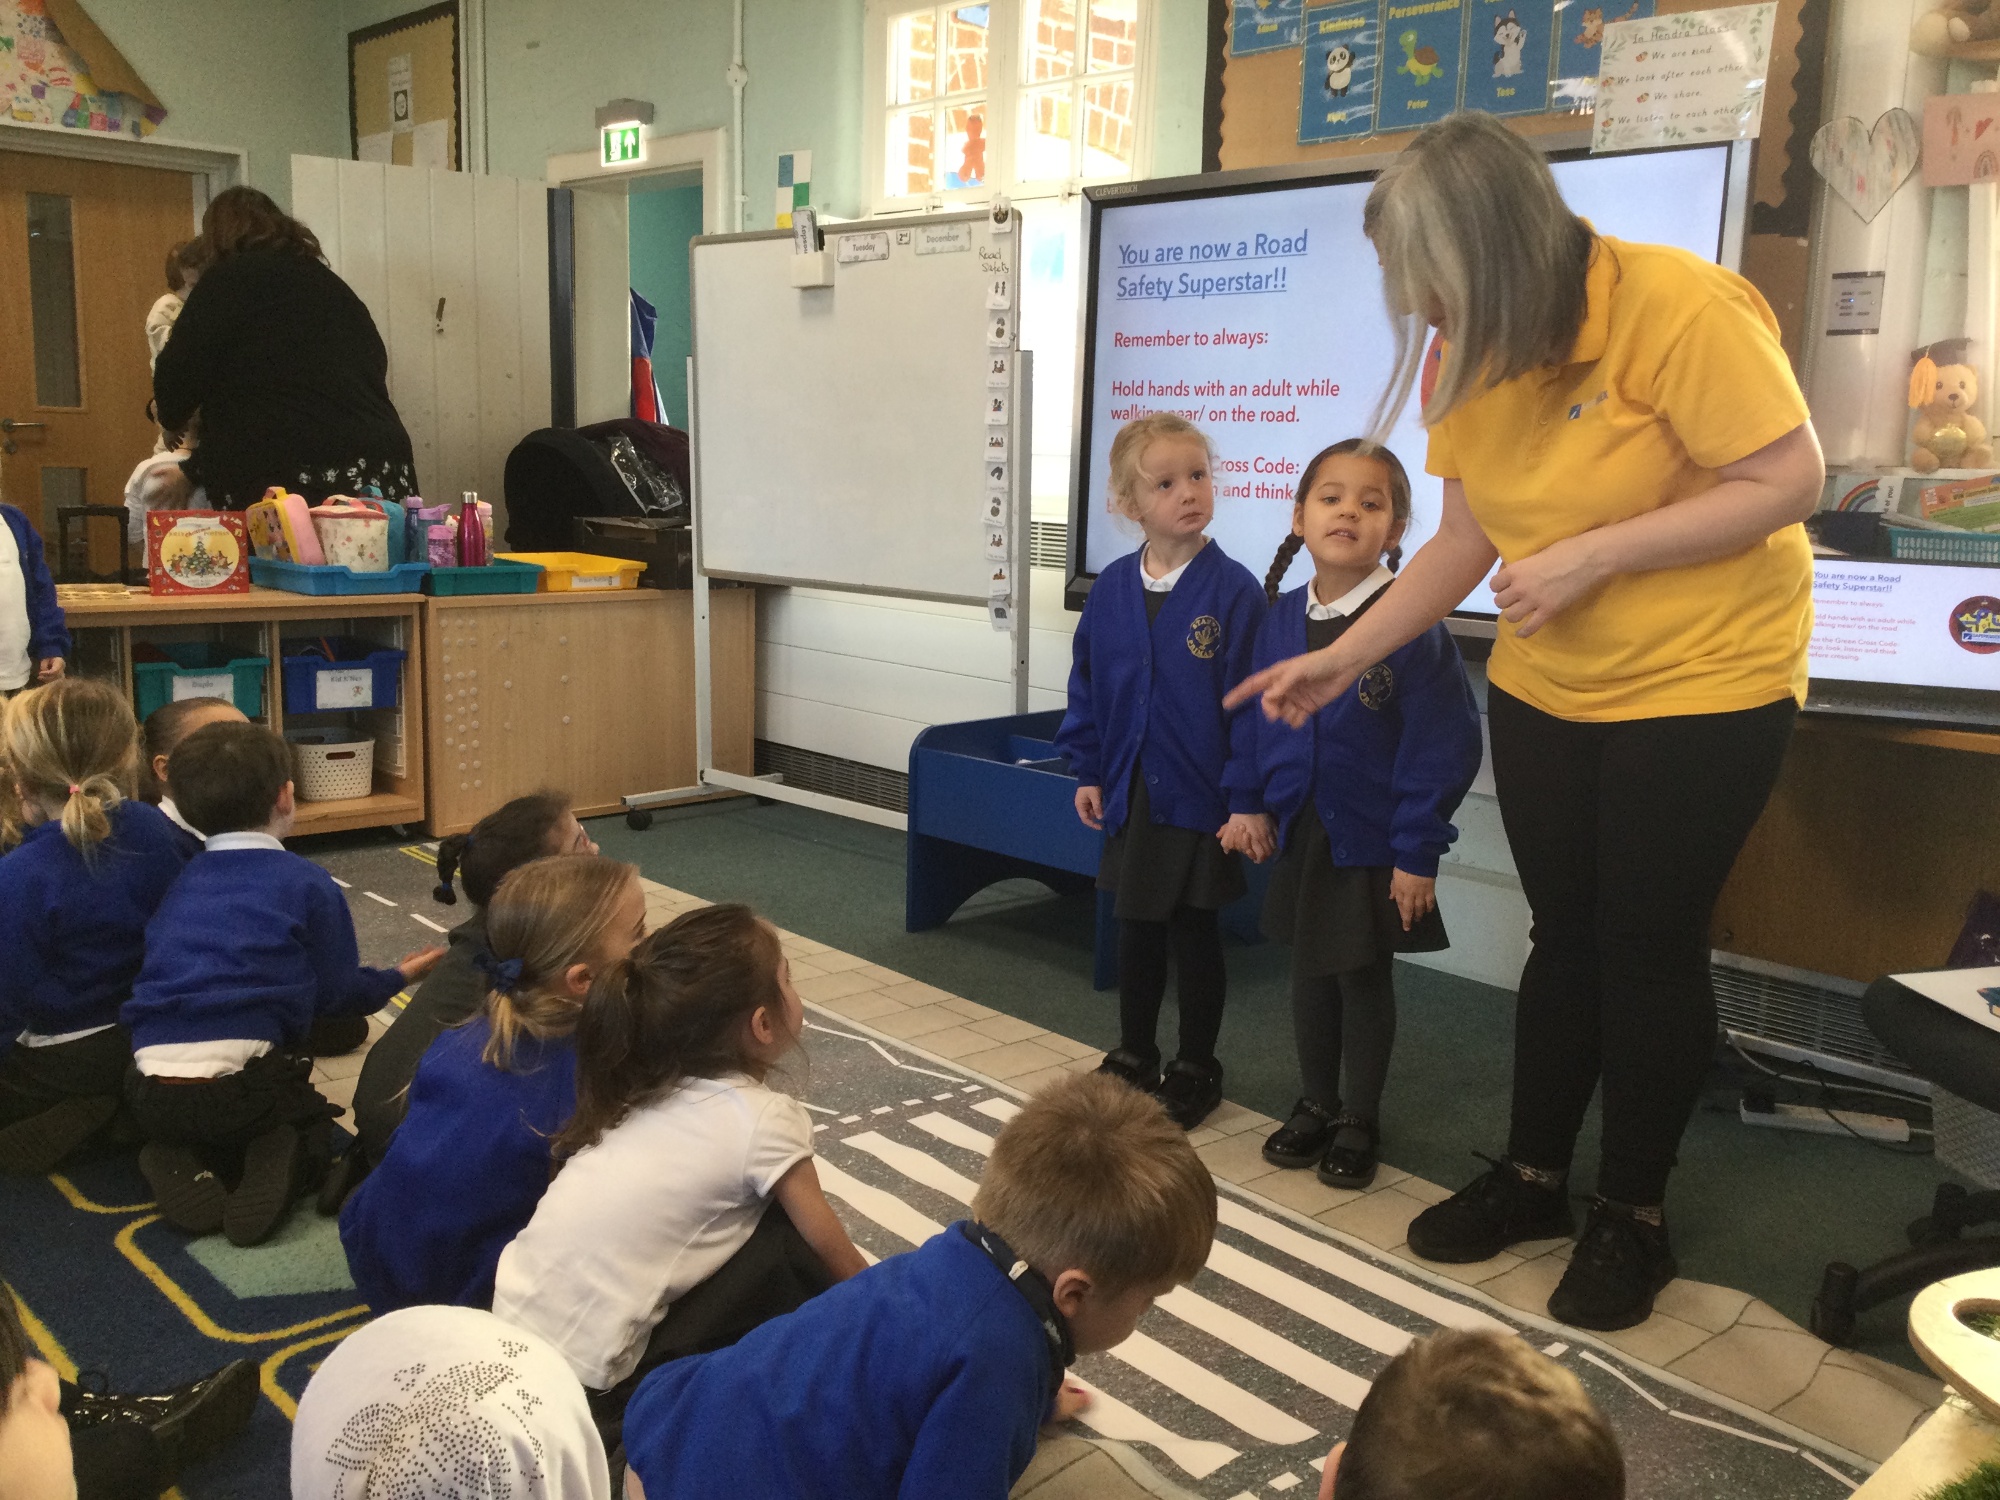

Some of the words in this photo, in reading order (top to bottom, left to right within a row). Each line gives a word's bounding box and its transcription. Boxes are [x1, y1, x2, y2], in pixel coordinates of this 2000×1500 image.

[1698, 26, 1730, 36] Class
[1652, 52, 1666, 60] We
[1617, 76, 1630, 84] We
[1635, 73, 1655, 83] look
[1660, 70, 1685, 82] after
[1690, 67, 1712, 76] each
[800, 224, 808, 254] nesday
[852, 243, 876, 253] Tuesday
[926, 234, 960, 244] December
[1119, 244, 1150, 265] You
[1154, 245, 1184, 263] are
[1189, 242, 1231, 260] now
[1236, 241, 1248, 257] a
[1254, 229, 1308, 255] Road
[1116, 274, 1173, 301] Safety
[1178, 266, 1287, 299] Superstar!!
[1114, 330, 1190, 348] Remember
[1194, 331, 1209, 346] to
[1213, 328, 1269, 349] always:
[1112, 380, 1144, 397] Hold
[1148, 380, 1190, 397] hands
[1194, 380, 1226, 397] with
[1230, 382, 1248, 397] an
[1252, 379, 1292, 397] adult
[1296, 379, 1340, 397] while
[1209, 408, 1227, 422] on
[1232, 406, 1256, 422] the
[1260, 406, 1300, 422] road.
[1254, 456, 1300, 474] Code:
[1223, 481, 1251, 498] and
[1255, 482, 1294, 500] think
[1814, 571, 1829, 579] You
[1878, 574, 1902, 582] Road
[1843, 582, 1893, 592] Superstar!!
